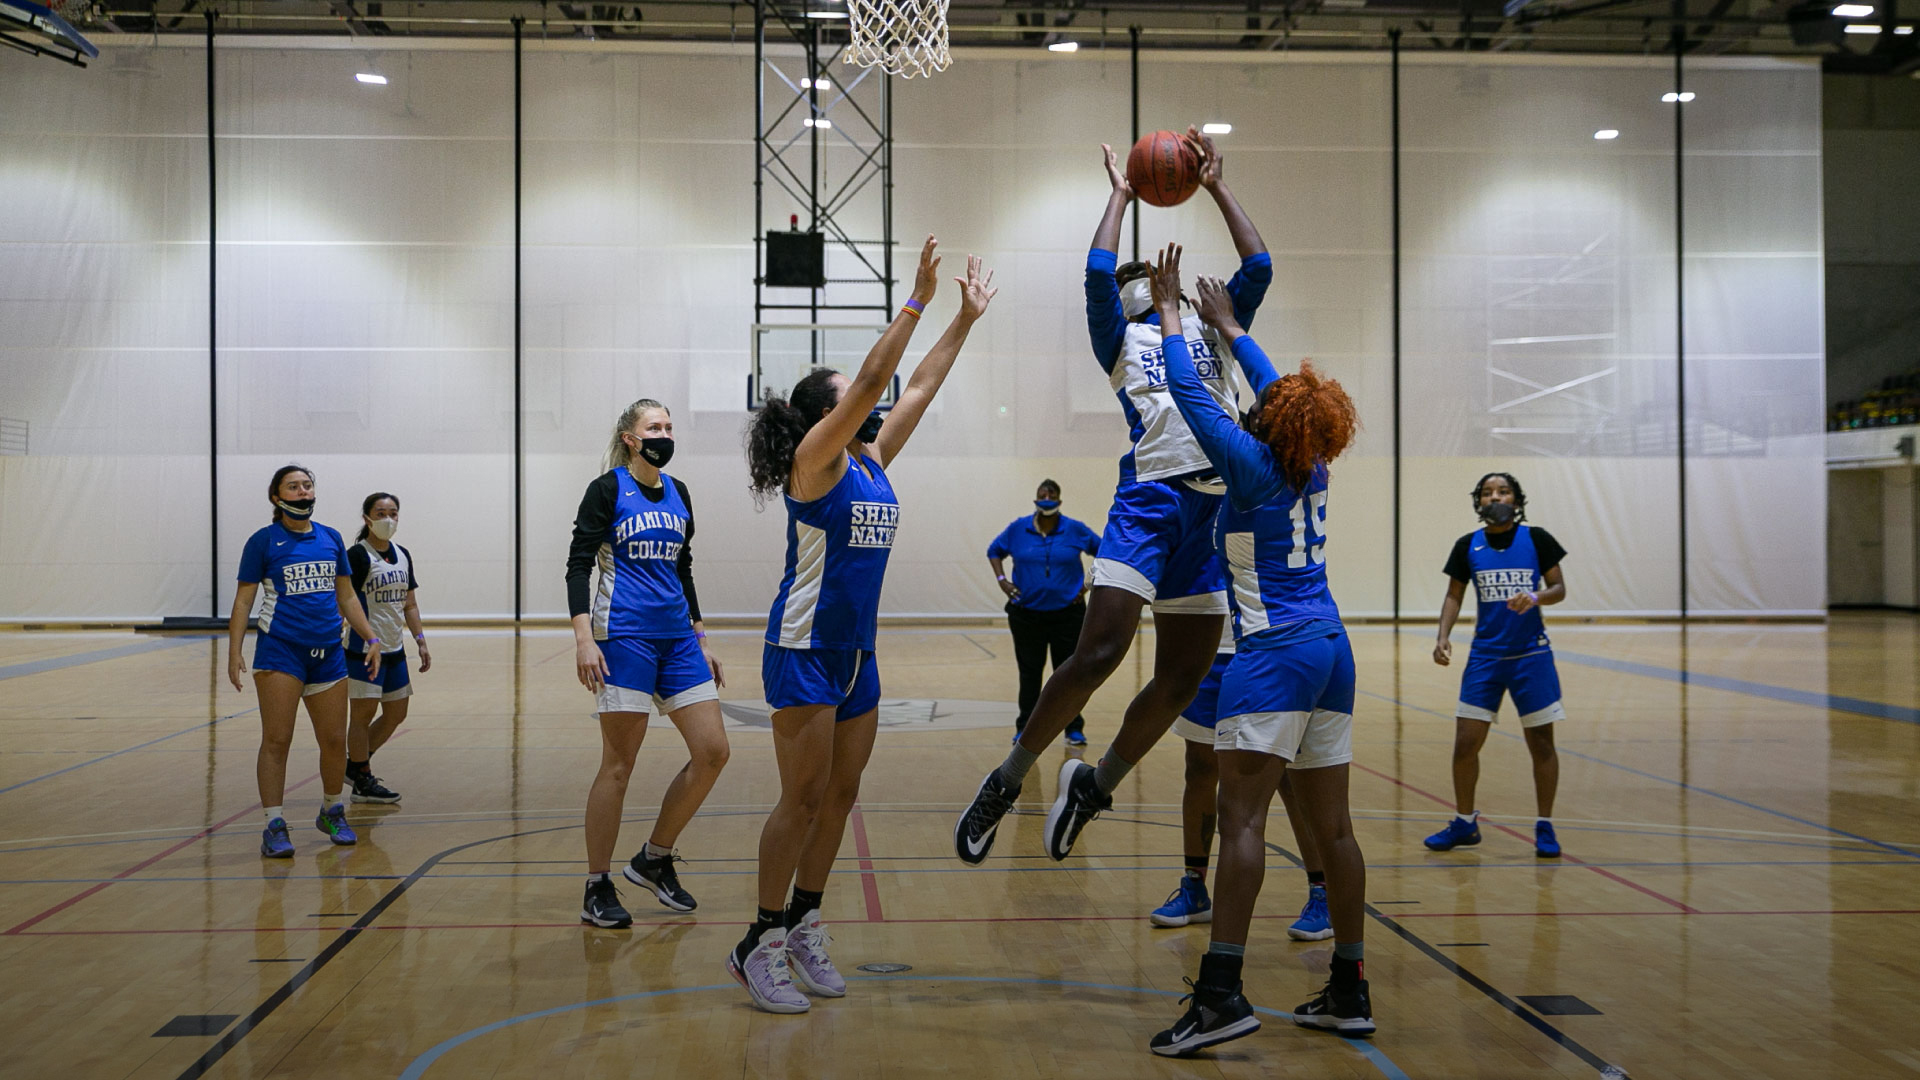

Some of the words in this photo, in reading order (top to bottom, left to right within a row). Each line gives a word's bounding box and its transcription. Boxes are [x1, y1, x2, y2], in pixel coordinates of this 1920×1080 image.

[615, 511, 662, 546] MIAMI
[365, 570, 399, 596] MIAMI
[1476, 571, 1534, 587] SHARK
